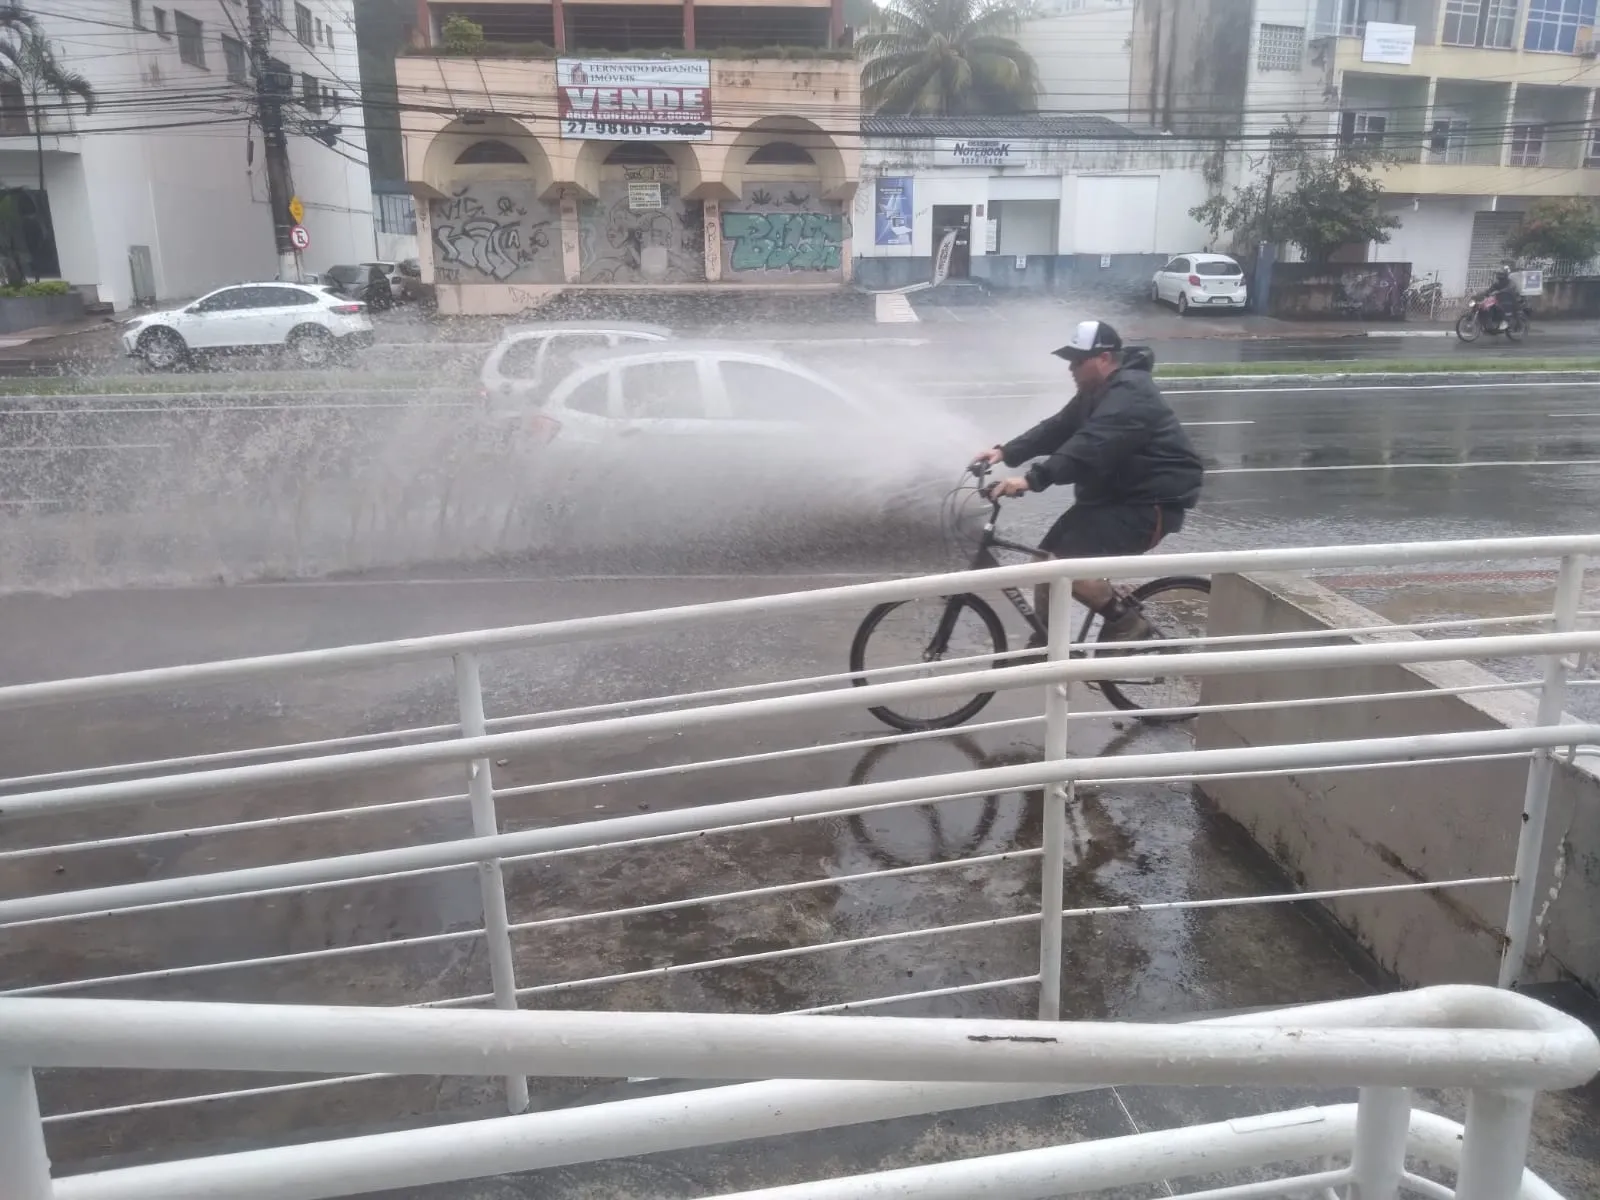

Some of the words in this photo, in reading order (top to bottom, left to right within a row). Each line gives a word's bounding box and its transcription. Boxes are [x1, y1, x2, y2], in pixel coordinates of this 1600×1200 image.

[589, 64, 649, 73] FERNANDO
[651, 65, 702, 73] PAGANINI
[565, 88, 705, 111] VENDE
